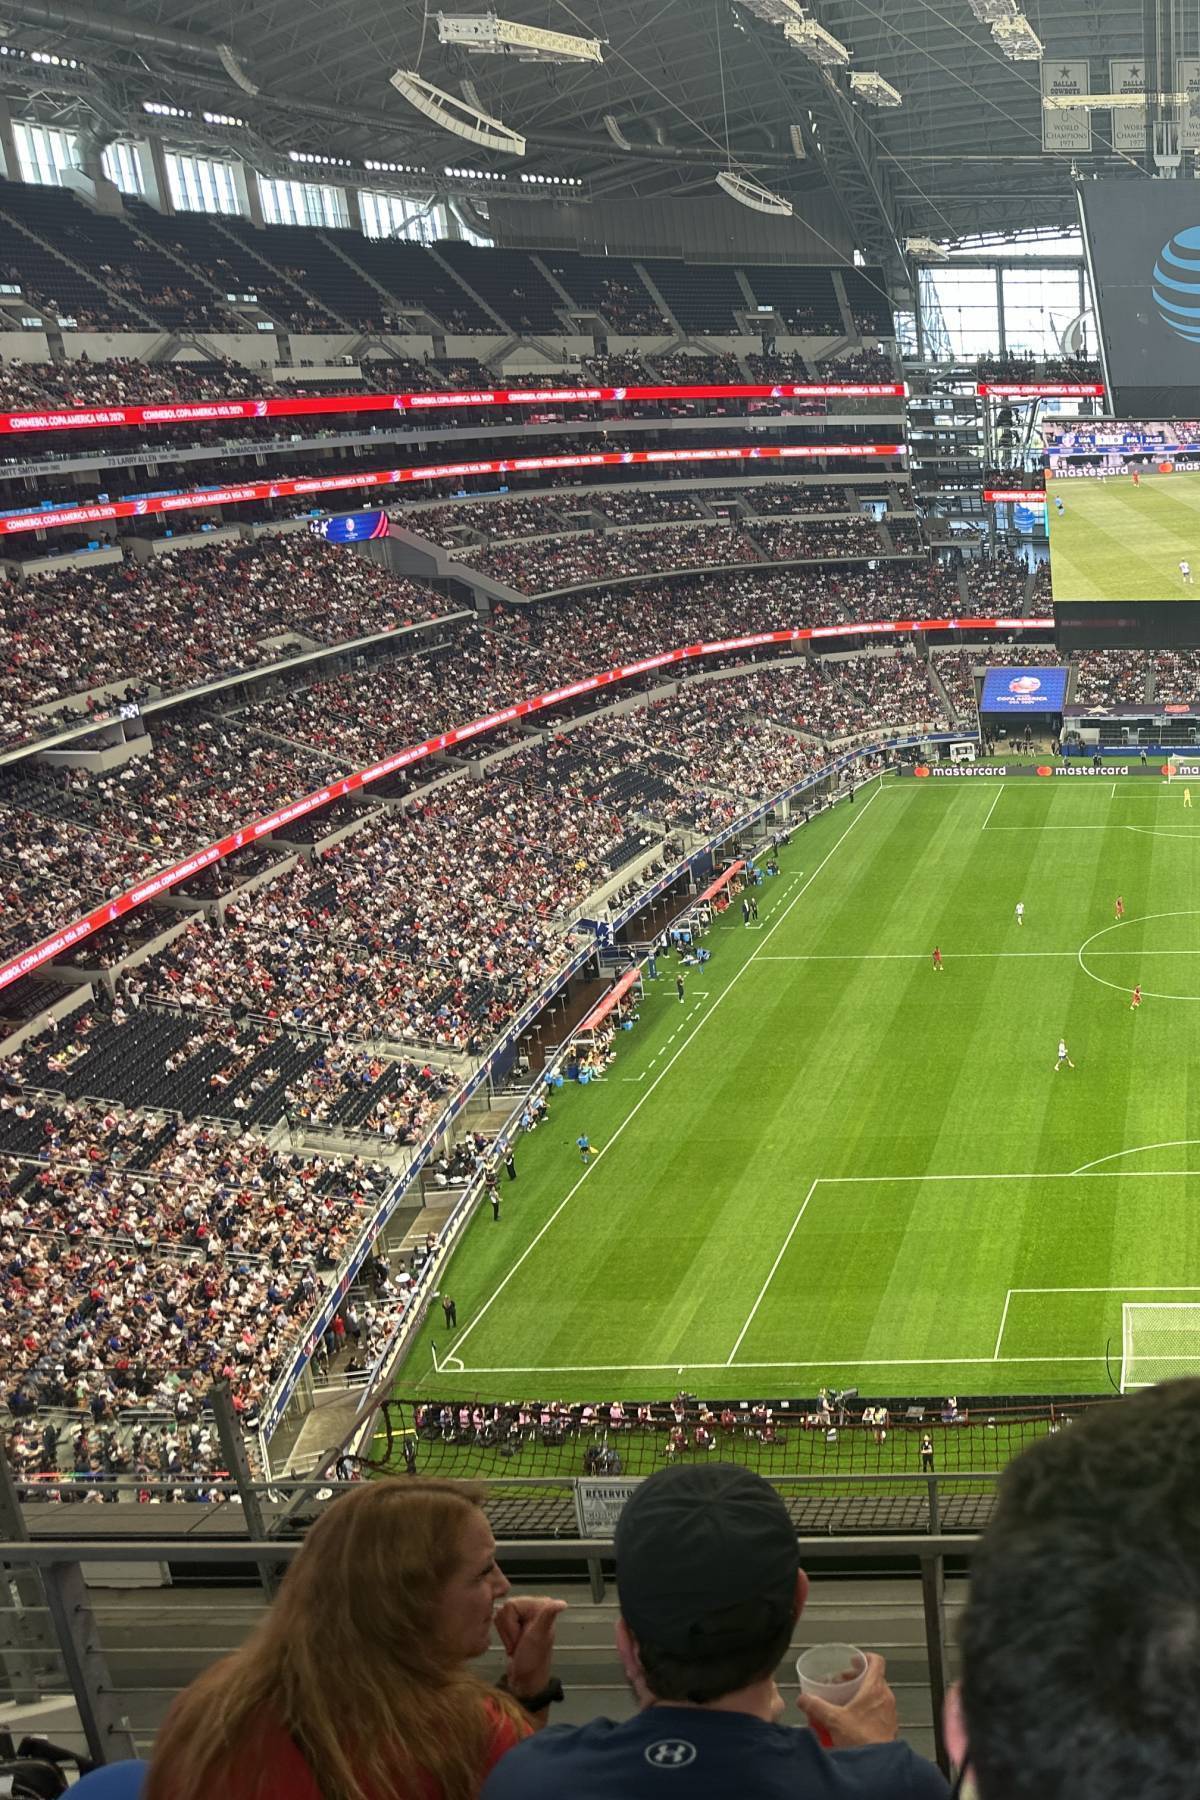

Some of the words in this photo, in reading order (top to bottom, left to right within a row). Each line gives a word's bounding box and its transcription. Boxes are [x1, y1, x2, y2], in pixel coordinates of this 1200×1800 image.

[1053, 80, 1077, 88] DALLAS
[117, 456, 135, 466] LARRY
[136, 455, 157, 464] ALLEN
[18, 466, 38, 475] SMITH
[933, 766, 1006, 776] mastercard
[1055, 766, 1129, 775] mastercard
